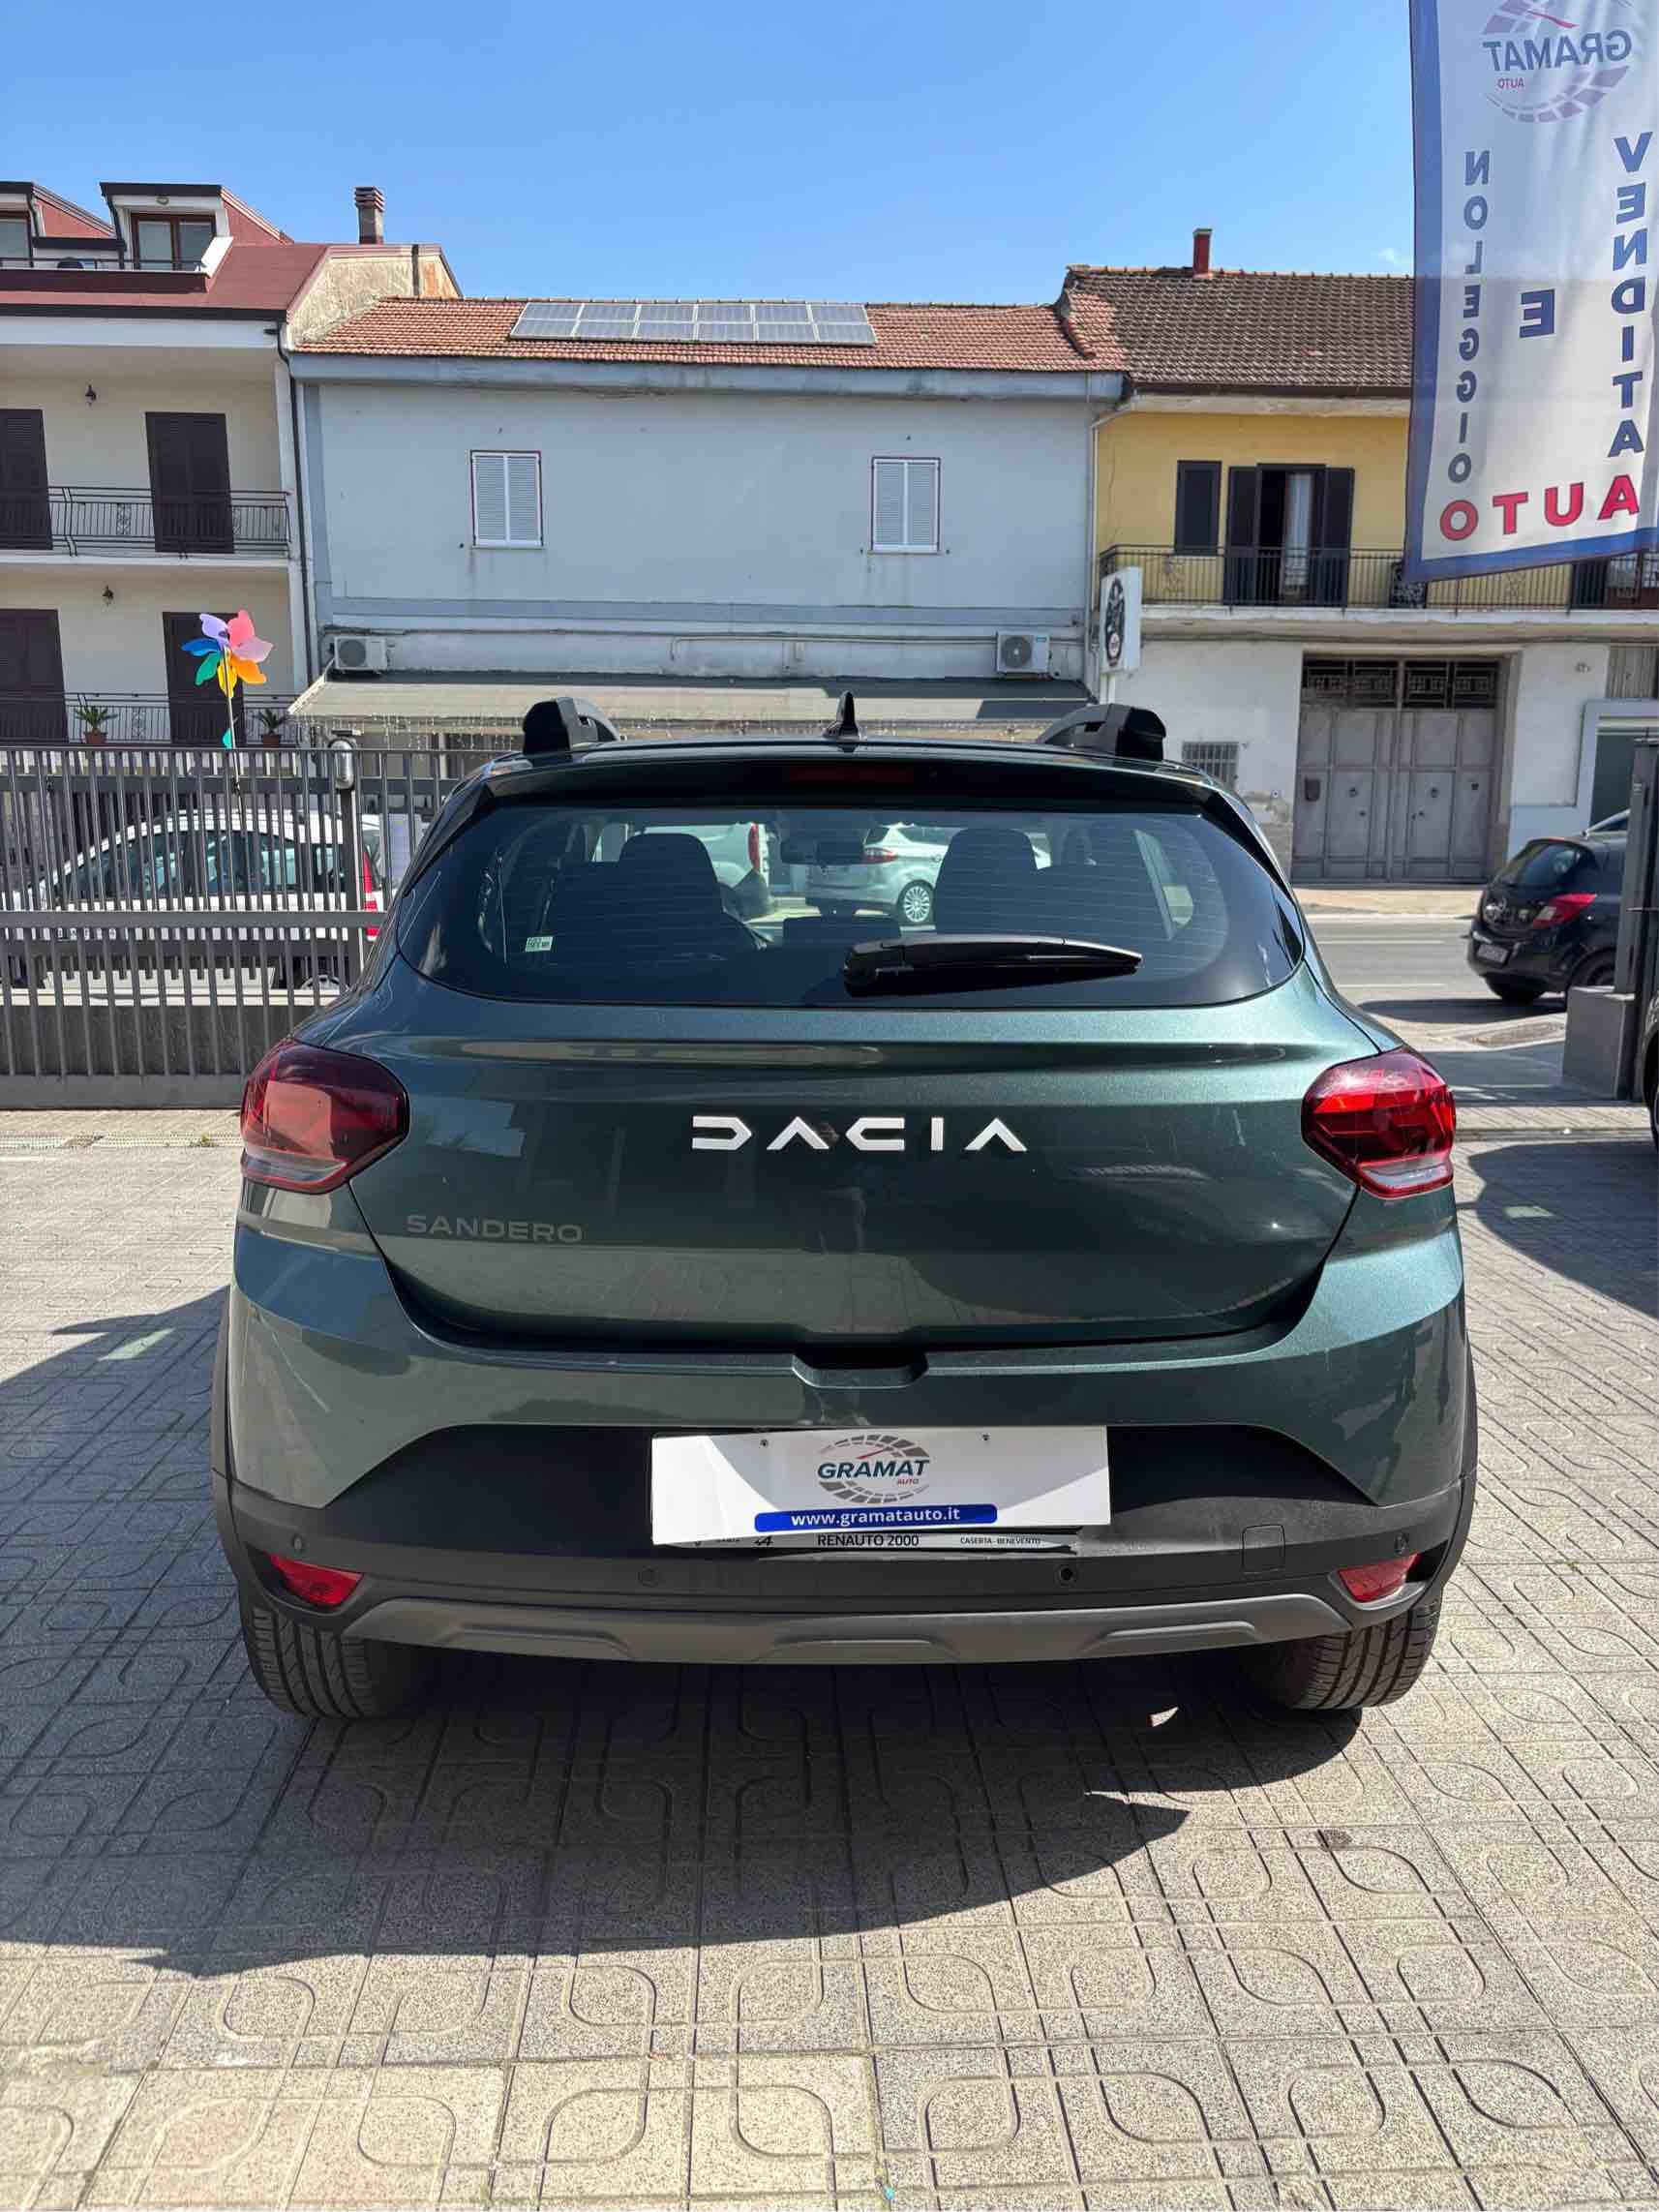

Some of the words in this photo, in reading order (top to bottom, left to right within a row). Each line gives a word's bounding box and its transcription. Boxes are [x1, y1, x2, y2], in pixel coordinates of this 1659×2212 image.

[691, 1115, 1028, 1153] DACIA
[406, 1213, 584, 1245] SANDERO
[817, 1459, 930, 1479] GRAMAT
[896, 1477, 920, 1486] AUTO
[790, 1504, 961, 1528] www.gramatauto.it
[817, 1533, 885, 1548] RENAUTO
[887, 1533, 920, 1547] 2000
[959, 1535, 992, 1545] CASERTA
